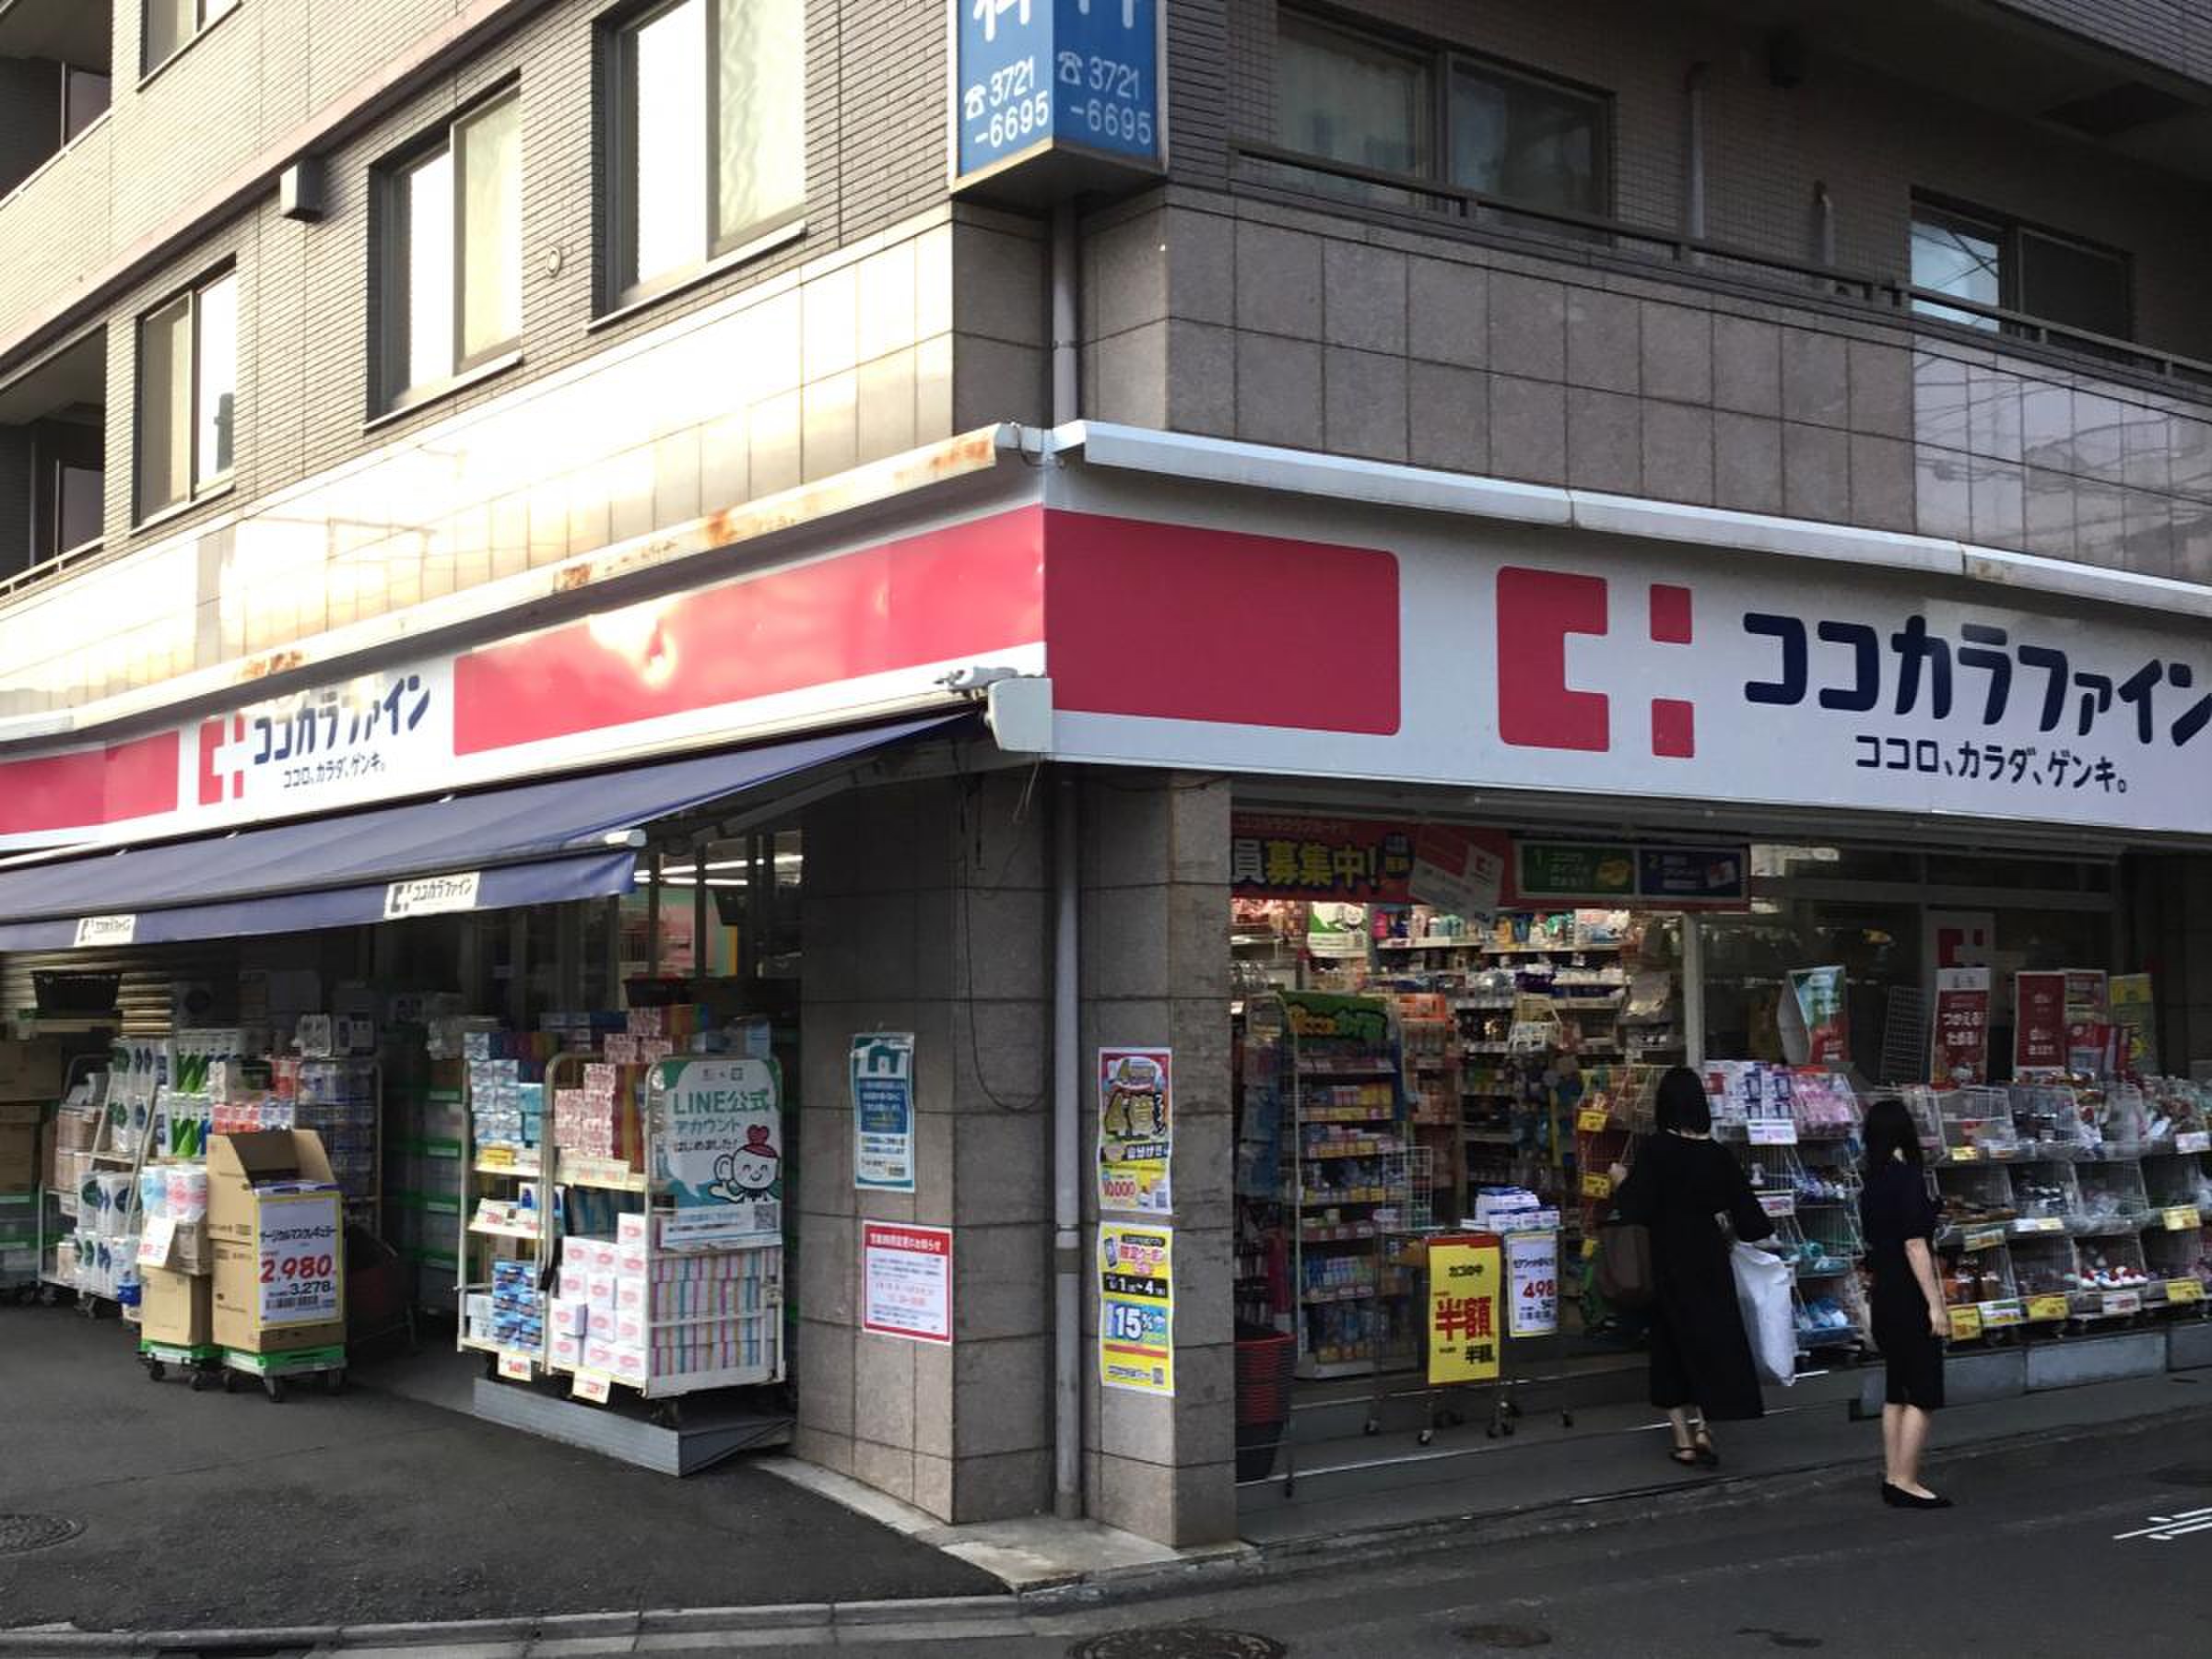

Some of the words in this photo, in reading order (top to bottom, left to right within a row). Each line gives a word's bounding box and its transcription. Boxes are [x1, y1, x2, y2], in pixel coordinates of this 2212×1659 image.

[989, 55, 1035, 108] 3721
[1088, 55, 1140, 100] 3721
[1743, 612, 2212, 747] ココカラファイン
[1855, 735, 2127, 794] ココロ、カラダ、ゲンキ。
[674, 1089, 769, 1114] LINE公式
[1435, 1296, 1492, 1342] 半額
